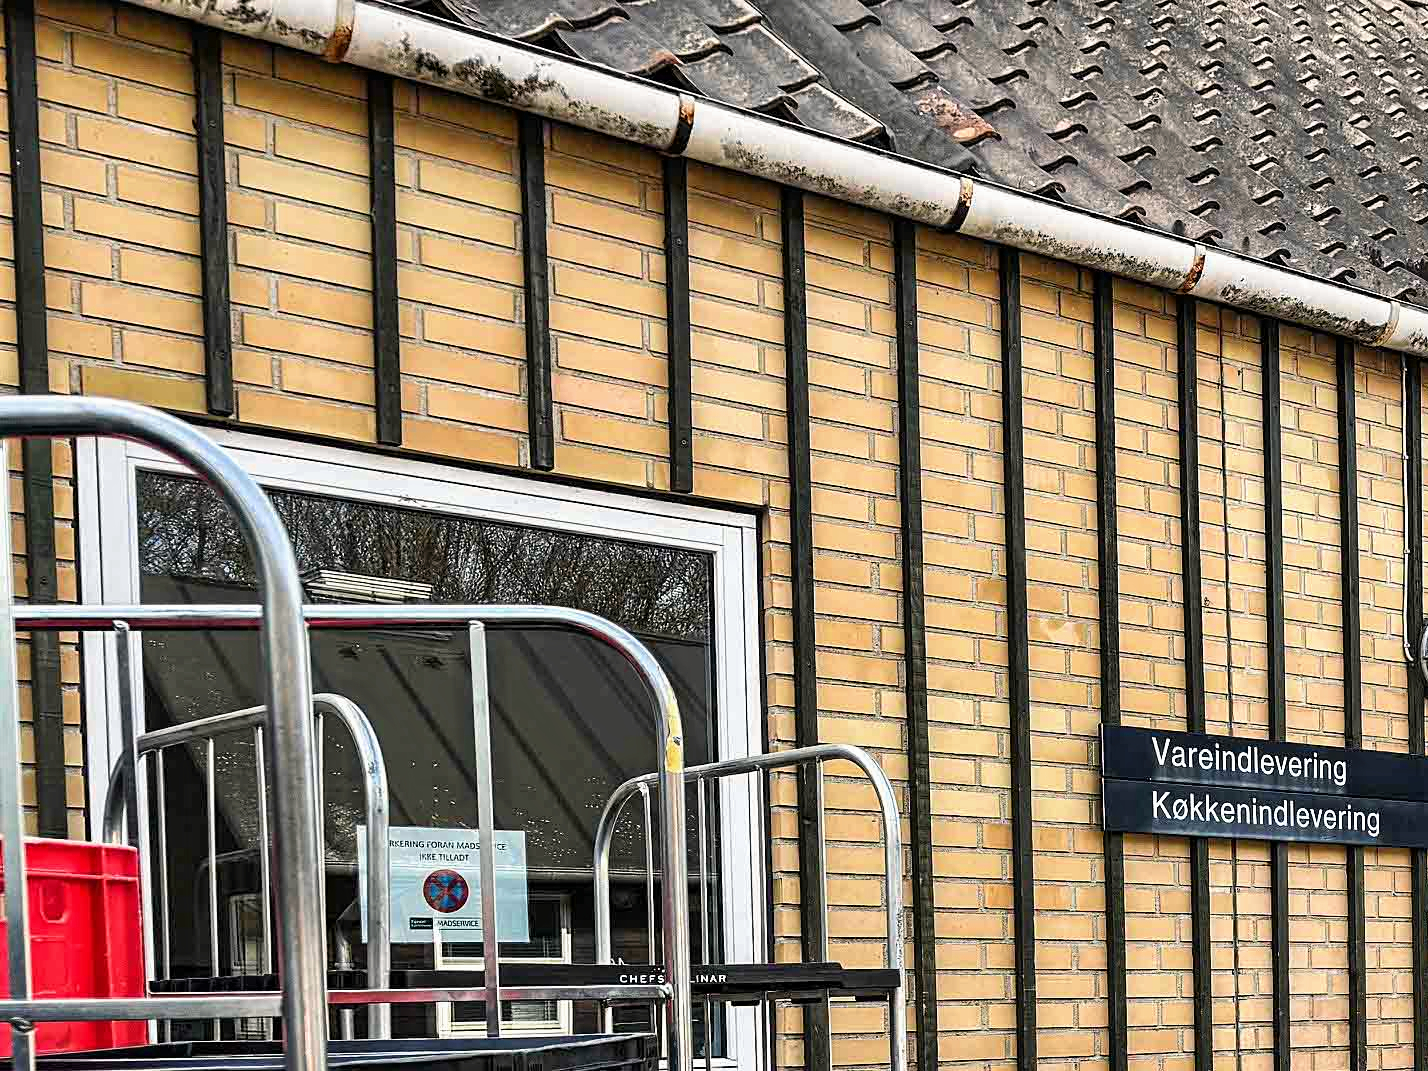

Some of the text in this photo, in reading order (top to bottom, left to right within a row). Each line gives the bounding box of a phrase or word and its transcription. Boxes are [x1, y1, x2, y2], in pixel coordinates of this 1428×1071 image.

[1151, 736, 1348, 786] Vareindlevering
[1151, 790, 1381, 838] Køkkenindlevering
[389, 839, 425, 849] RKERING
[456, 841, 507, 851] MADSICE
[419, 853, 470, 862] IKKE TILLADT
[437, 919, 479, 927] MADSERVICE
[619, 974, 665, 984] CHEFS
